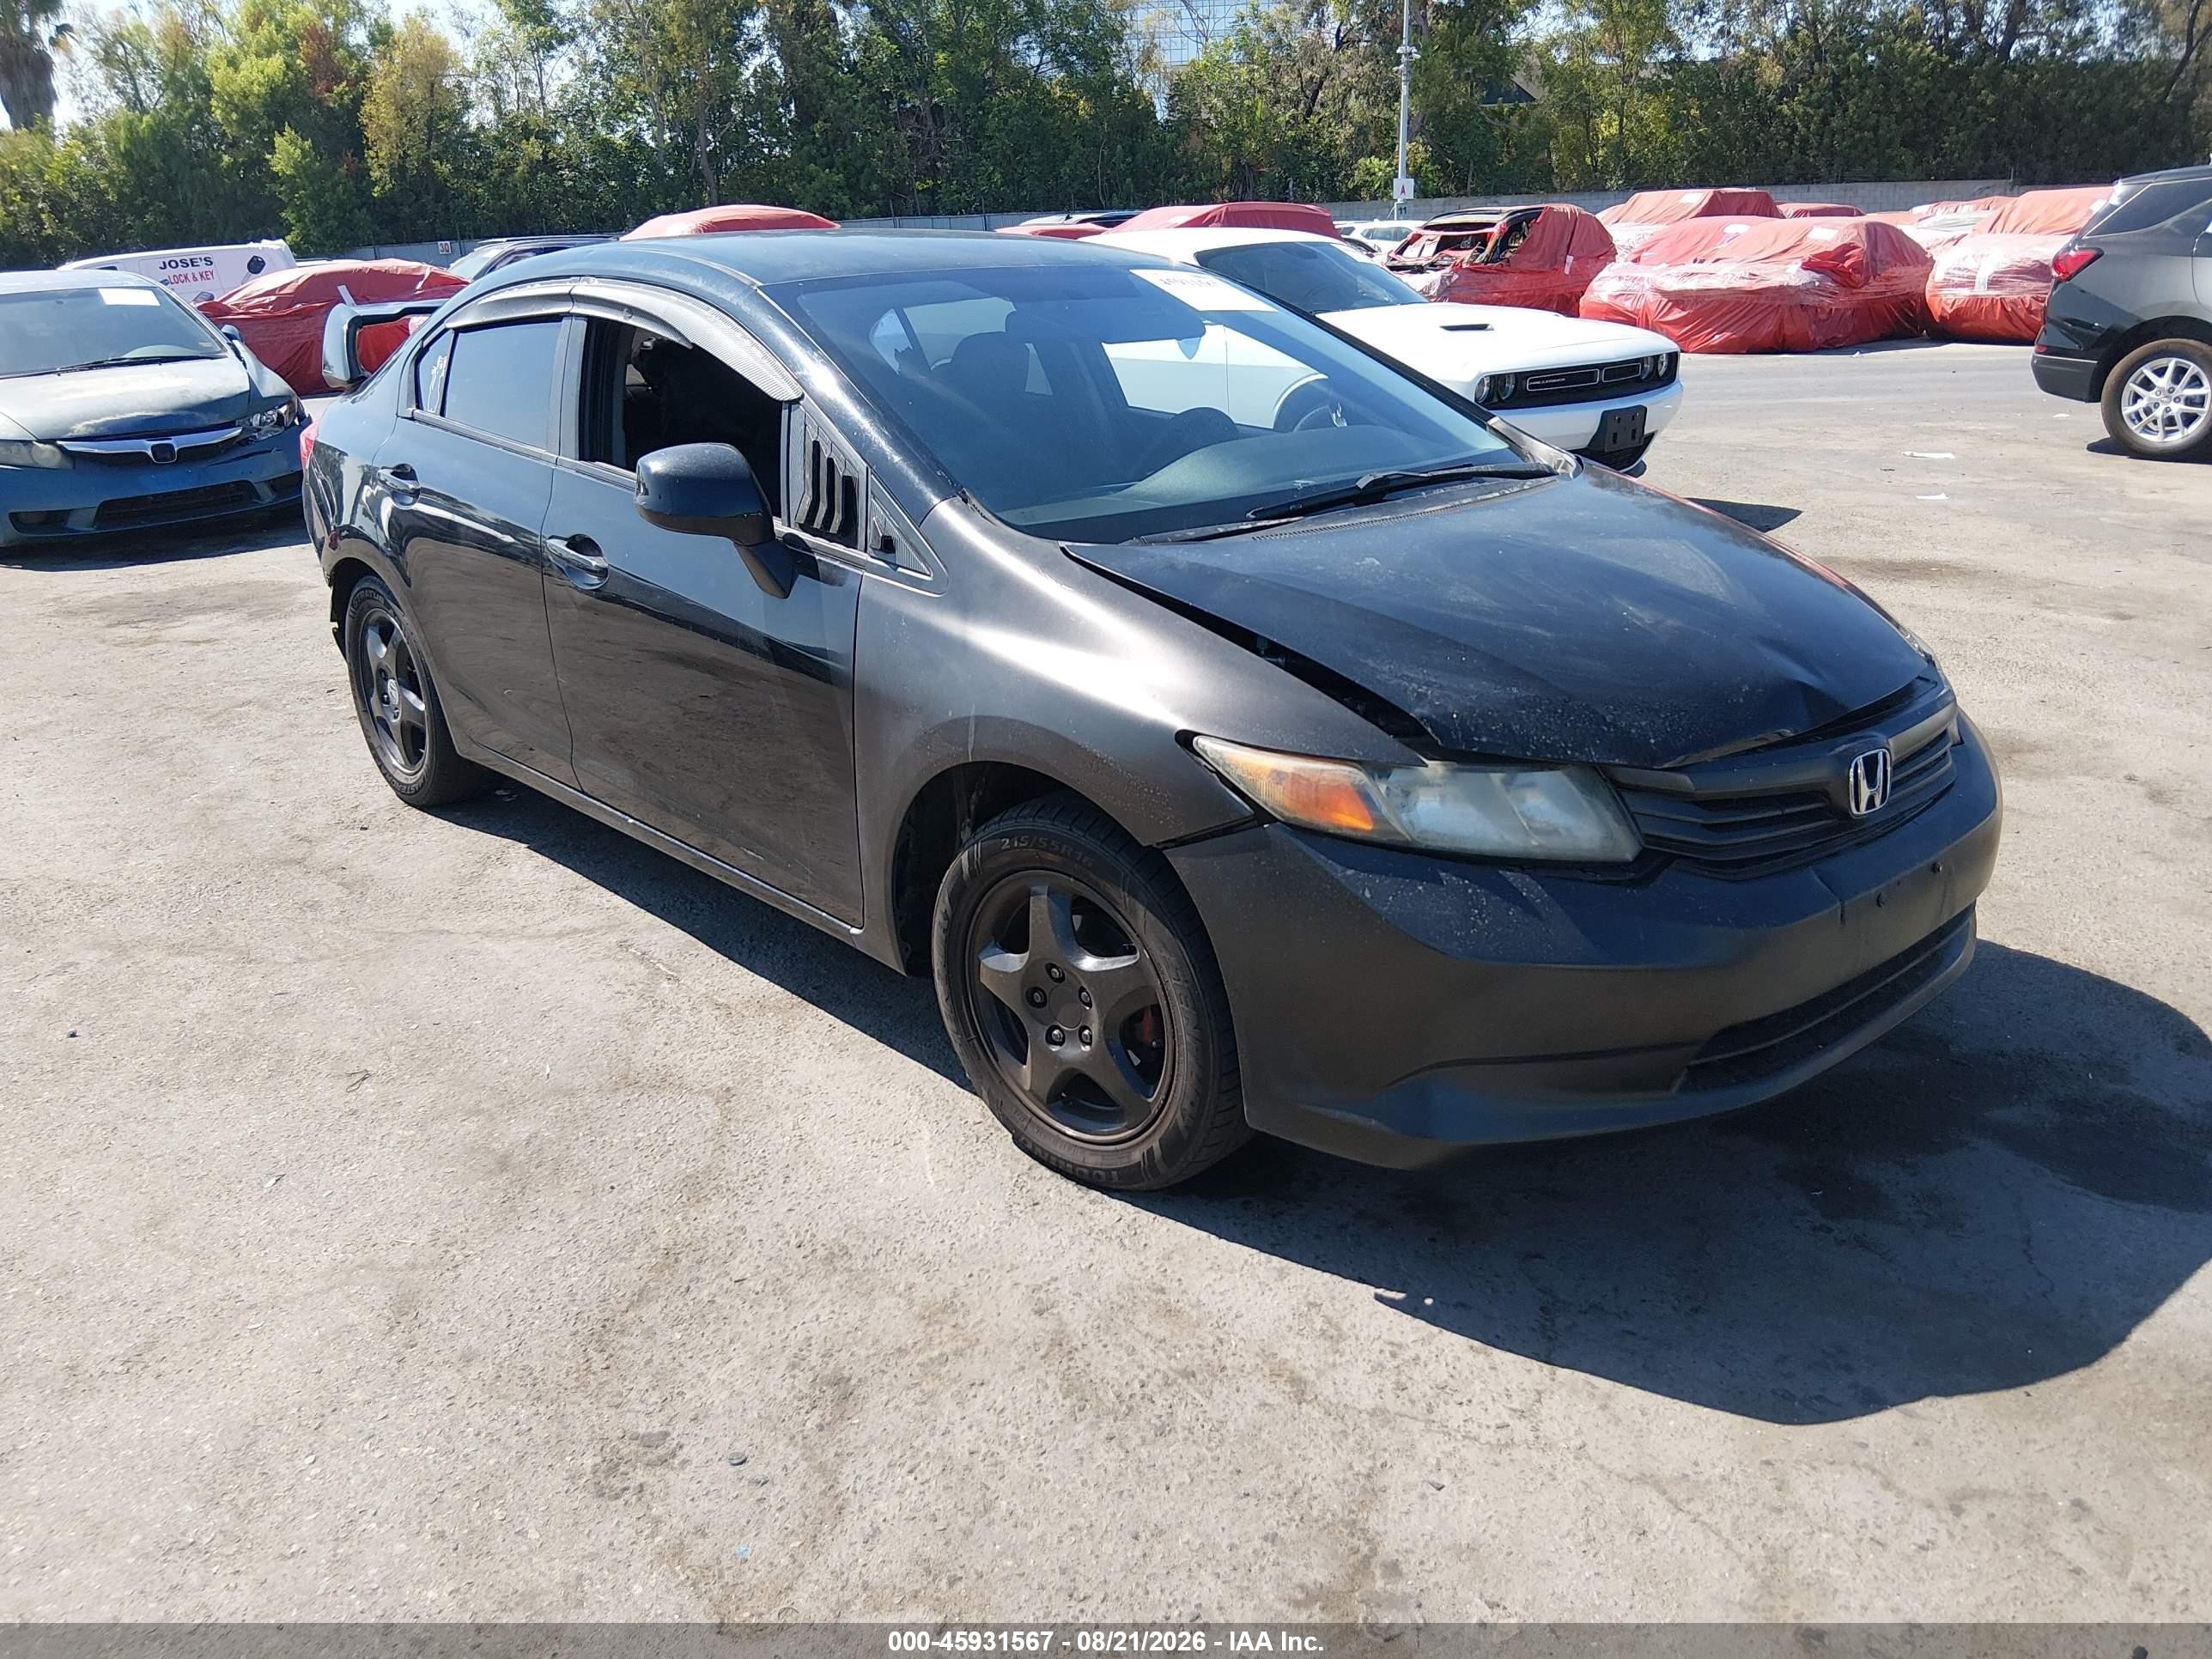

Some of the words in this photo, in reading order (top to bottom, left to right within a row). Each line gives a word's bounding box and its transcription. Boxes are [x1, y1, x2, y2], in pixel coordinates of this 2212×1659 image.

[1400, 184, 1407, 196] A
[439, 242, 450, 253] 30
[159, 257, 213, 270] JOSE'S
[167, 272, 189, 285] LOCK
[191, 272, 198, 281] &
[199, 270, 214, 281] KEY
